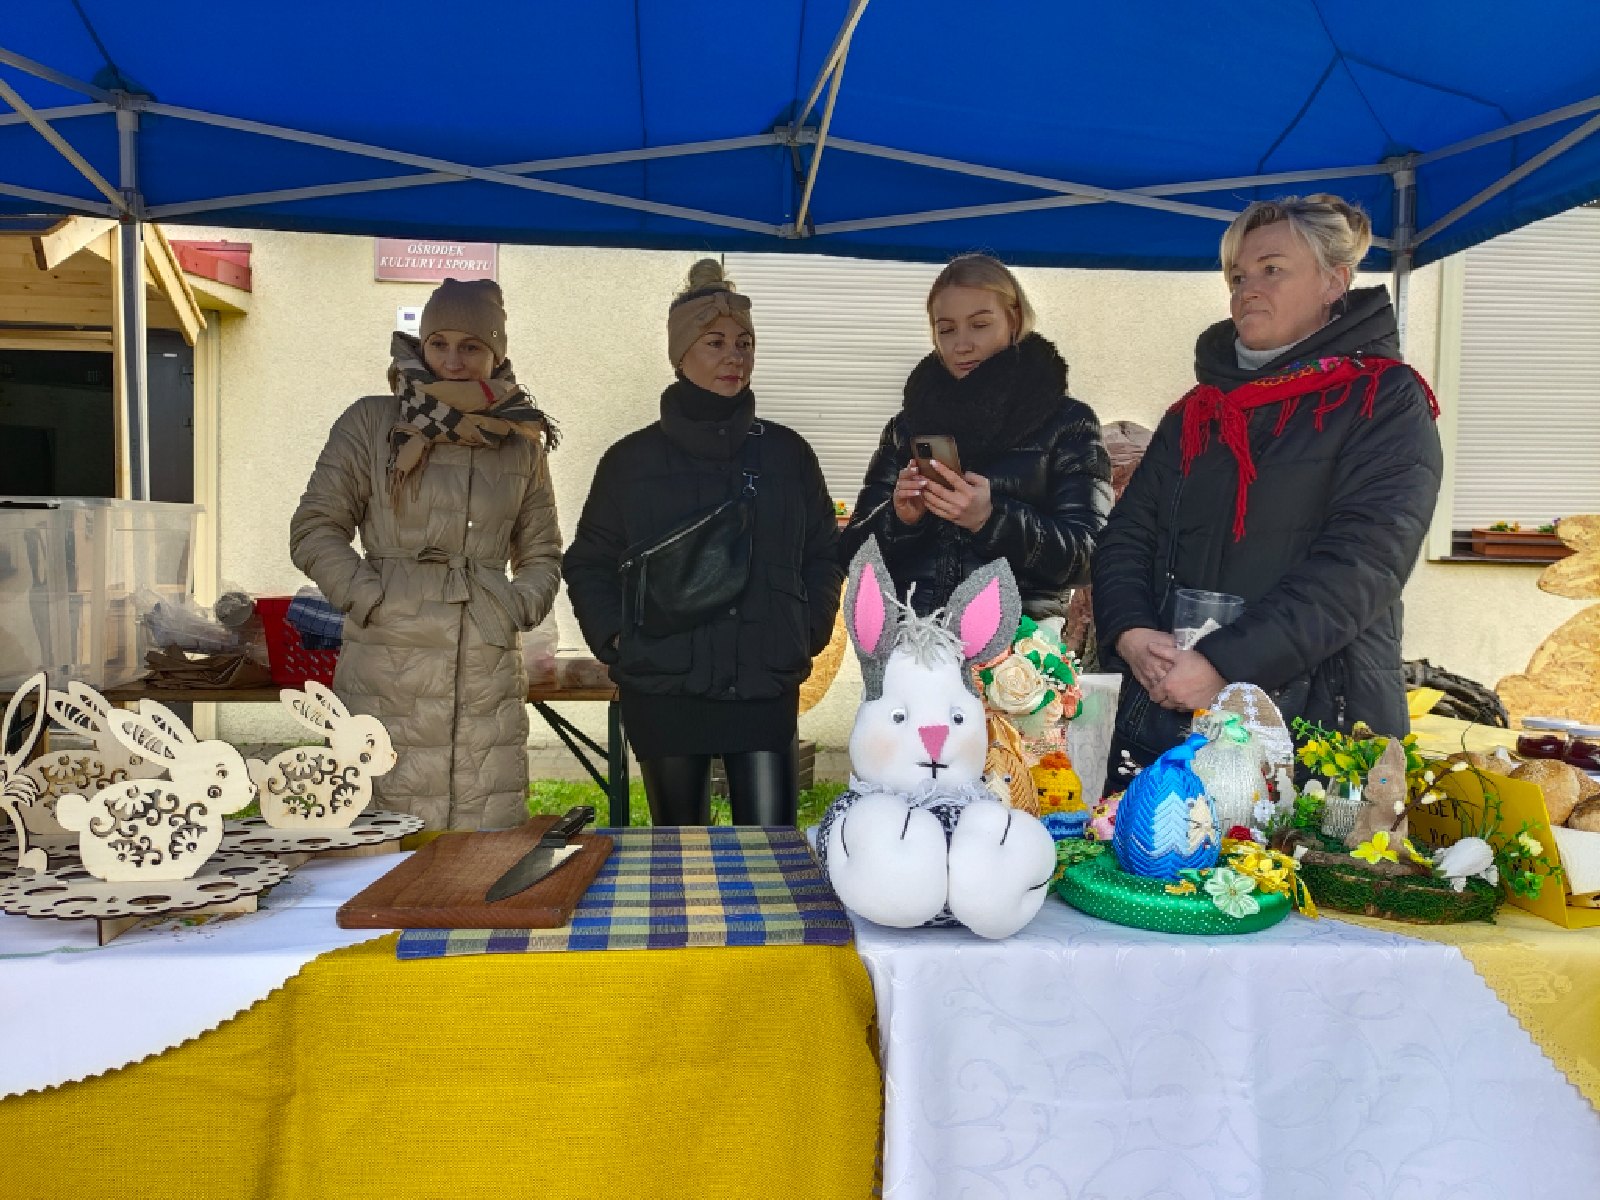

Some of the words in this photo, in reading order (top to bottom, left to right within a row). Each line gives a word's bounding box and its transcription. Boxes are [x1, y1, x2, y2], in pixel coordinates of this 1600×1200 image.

[407, 242, 466, 256] OŚRODEK
[379, 256, 435, 269] KULTURY
[438, 258, 444, 269] I
[445, 259, 492, 272] SPORTU
